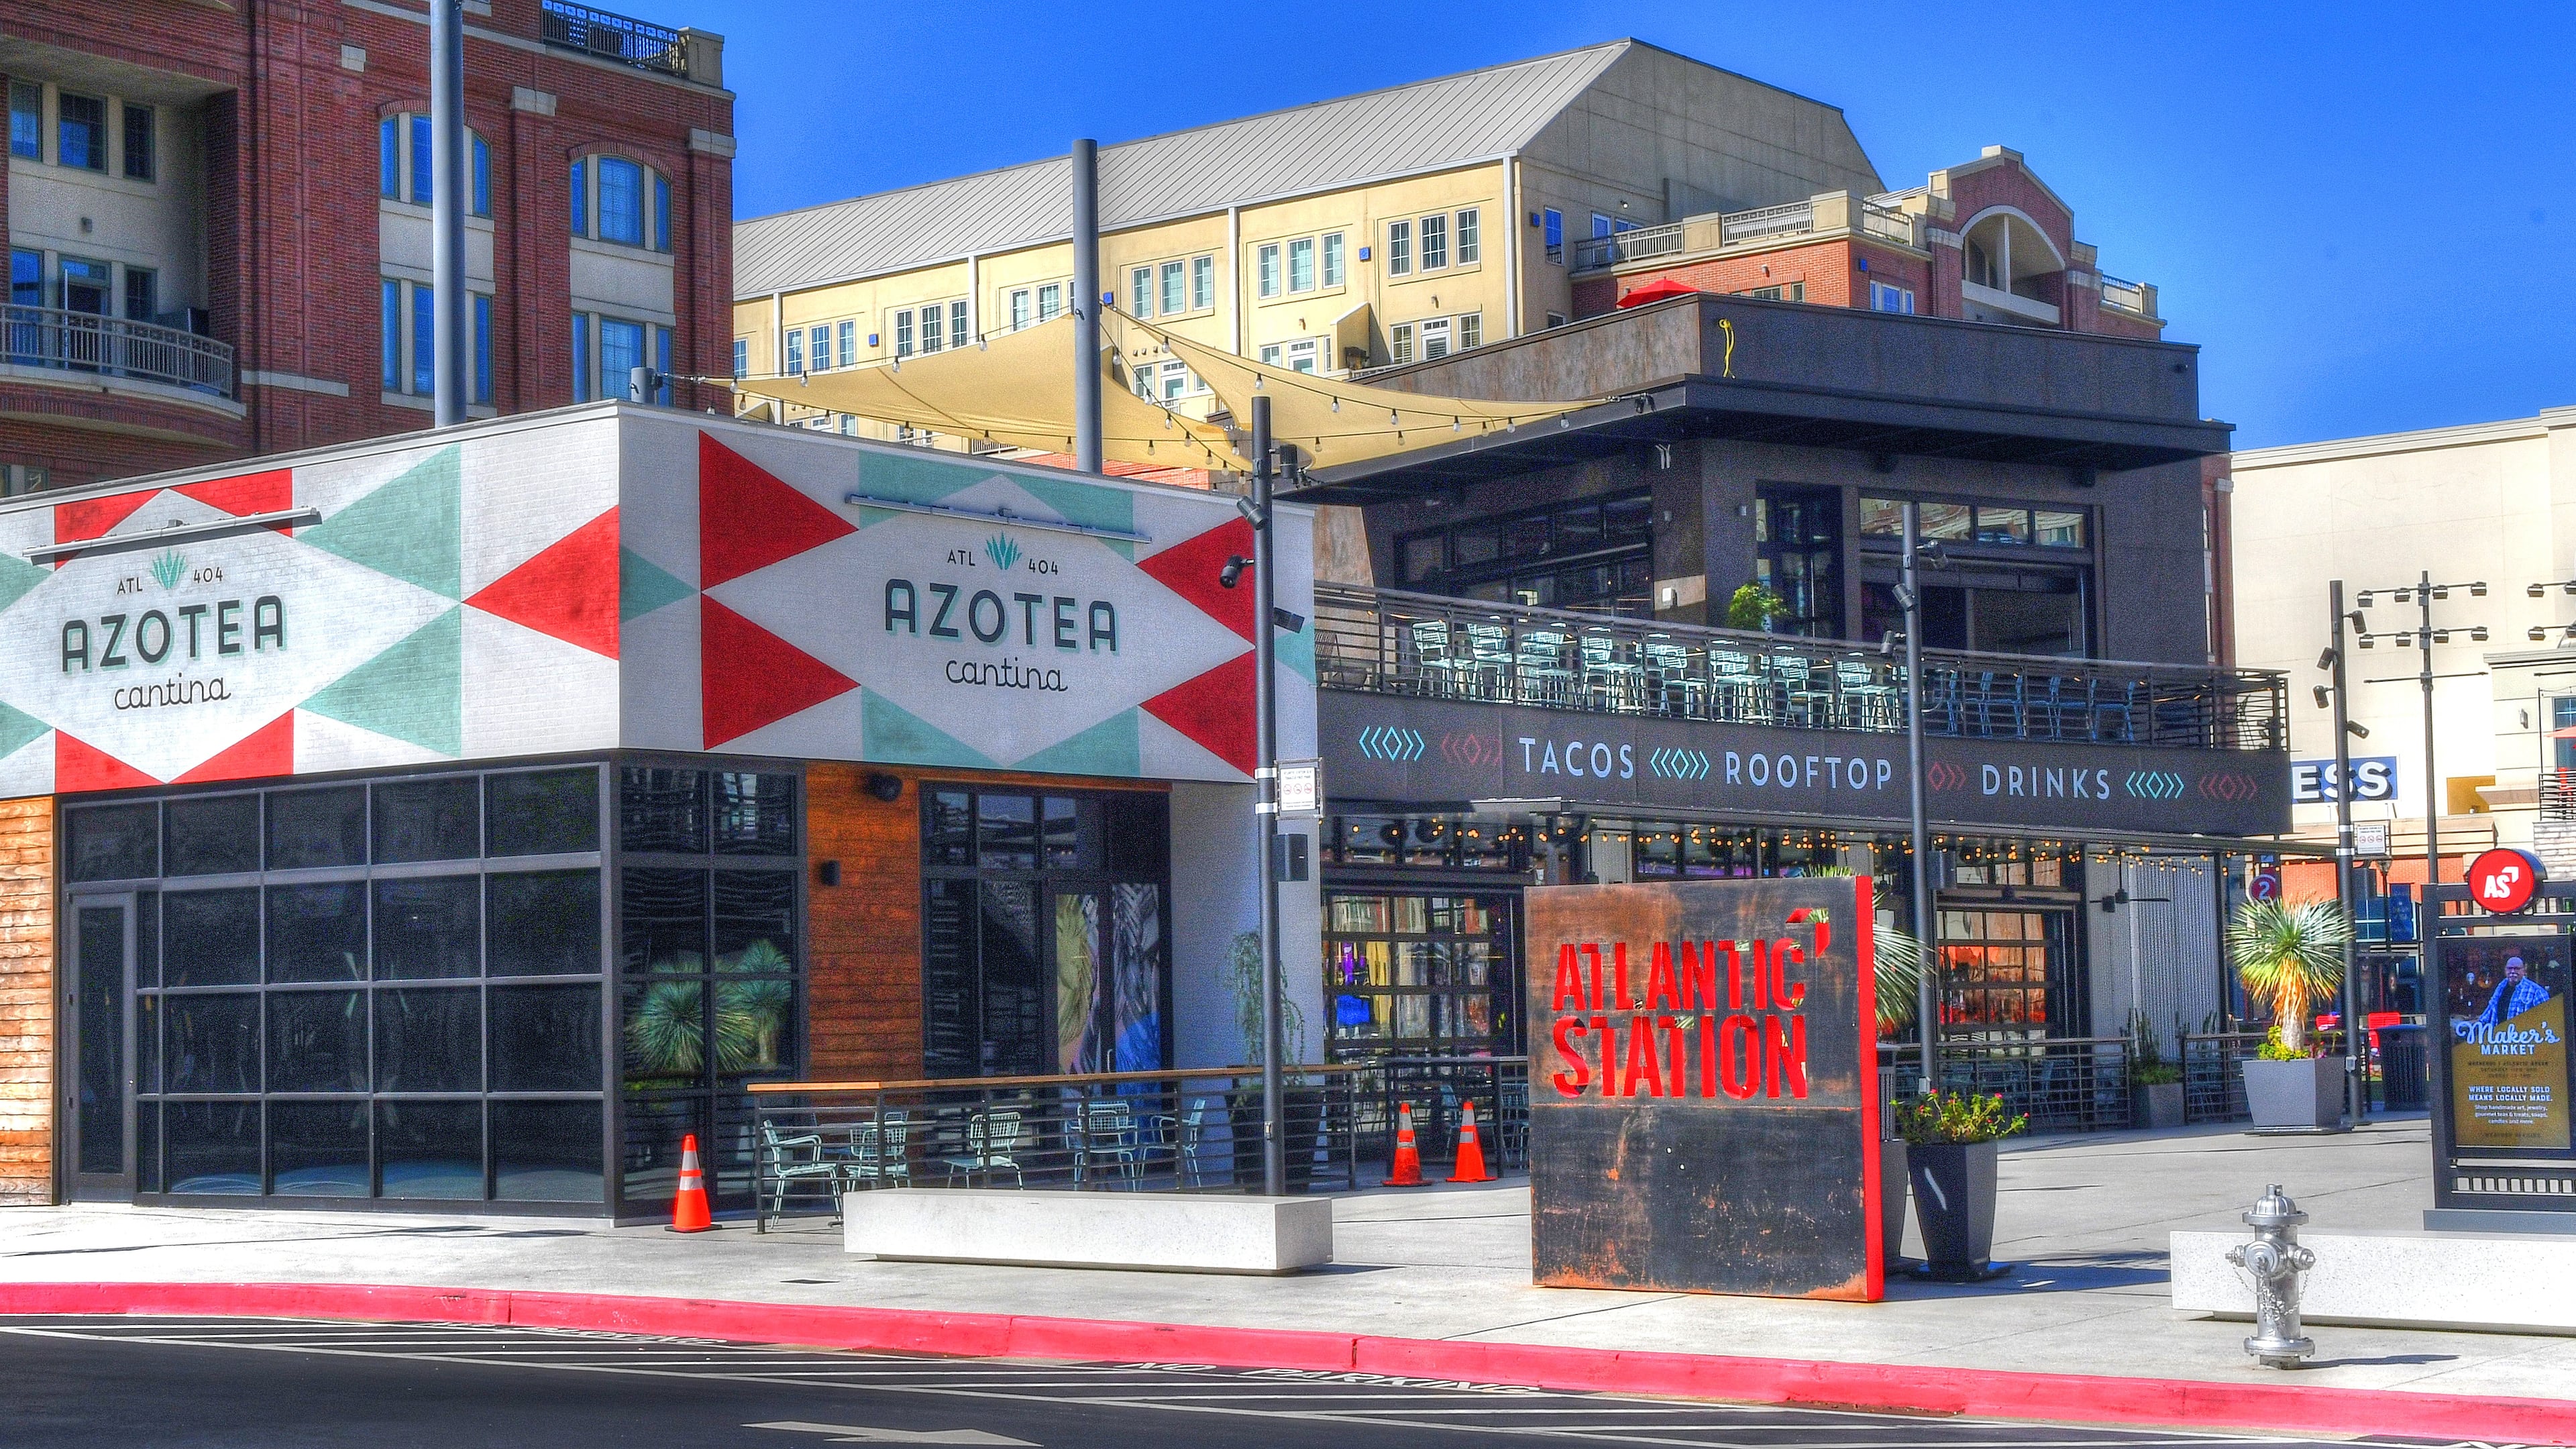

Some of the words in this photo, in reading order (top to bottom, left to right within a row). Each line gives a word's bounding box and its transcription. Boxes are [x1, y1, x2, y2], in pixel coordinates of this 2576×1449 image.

[947, 549, 975, 567] ATL
[1028, 558, 1059, 576] 404
[116, 577, 143, 596] ATL
[193, 567, 223, 584] 404
[62, 595, 286, 672] AZOTEA
[885, 578, 1118, 654] AZOTEA
[114, 672, 231, 710] cantina
[946, 657, 1068, 692] cantina
[1518, 737, 1634, 780] TACOS
[1725, 750, 1892, 790] ROOFTOP
[1982, 763, 2111, 800] DRINKS
[2483, 874, 2511, 899] AS
[1552, 937, 1805, 1010] ATLANTIC
[2455, 1021, 2561, 1044] Maker's
[2481, 1044, 2535, 1055] MARKET
[1552, 1014, 1809, 1100] STATION
[1114, 1362, 1217, 1372] NO
[1238, 1368, 1540, 1393] PARKING
